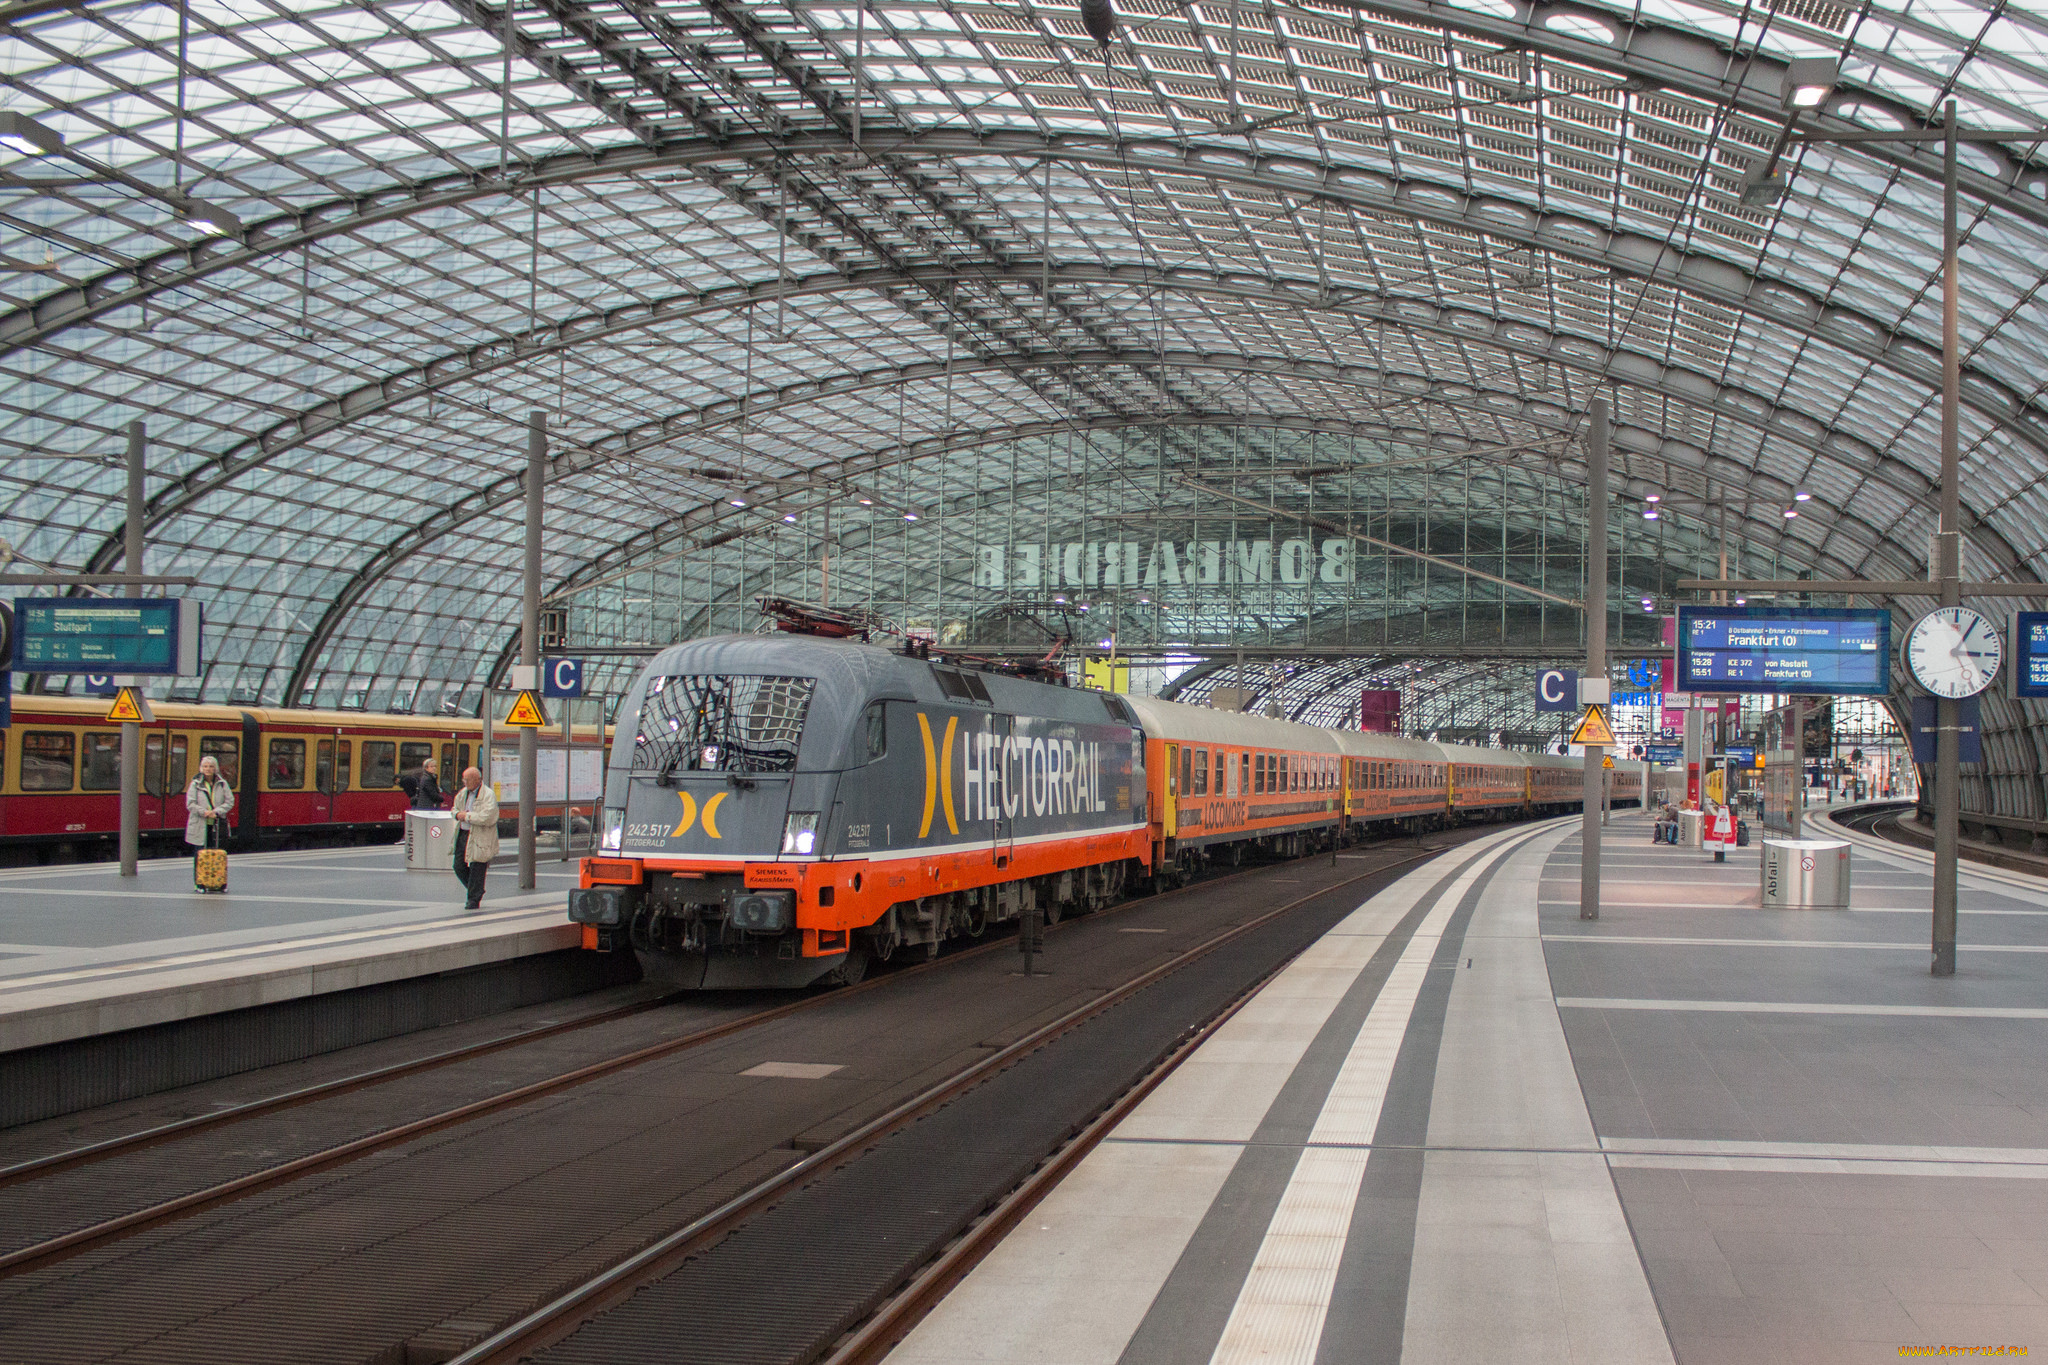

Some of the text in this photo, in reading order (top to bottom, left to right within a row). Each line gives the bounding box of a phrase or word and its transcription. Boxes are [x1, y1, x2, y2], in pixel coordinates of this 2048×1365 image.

[54, 622, 92, 634] Stuttgart
[1692, 620, 1716, 630] 15:21
[1728, 634, 1779, 646] Frankfurt
[1692, 658, 1712, 666] 15:28
[1740, 659, 1752, 667] 372
[1779, 660, 1808, 668] Rastatt
[554, 660, 576, 690] C
[1691, 668, 1712, 676] 15:51
[1727, 669, 1737, 677] RE
[1764, 669, 1799, 678] Frankfurt
[1541, 671, 1565, 703] C
[1662, 727, 1672, 737] 12
[963, 731, 1106, 821] HECTORRAIL
[1204, 801, 1245, 831] LOCOMORE
[627, 823, 671, 838] 242.517
[407, 830, 415, 862] Abfall
[625, 838, 666, 848] FITZGERALD
[1768, 862, 1778, 897] Abfall
